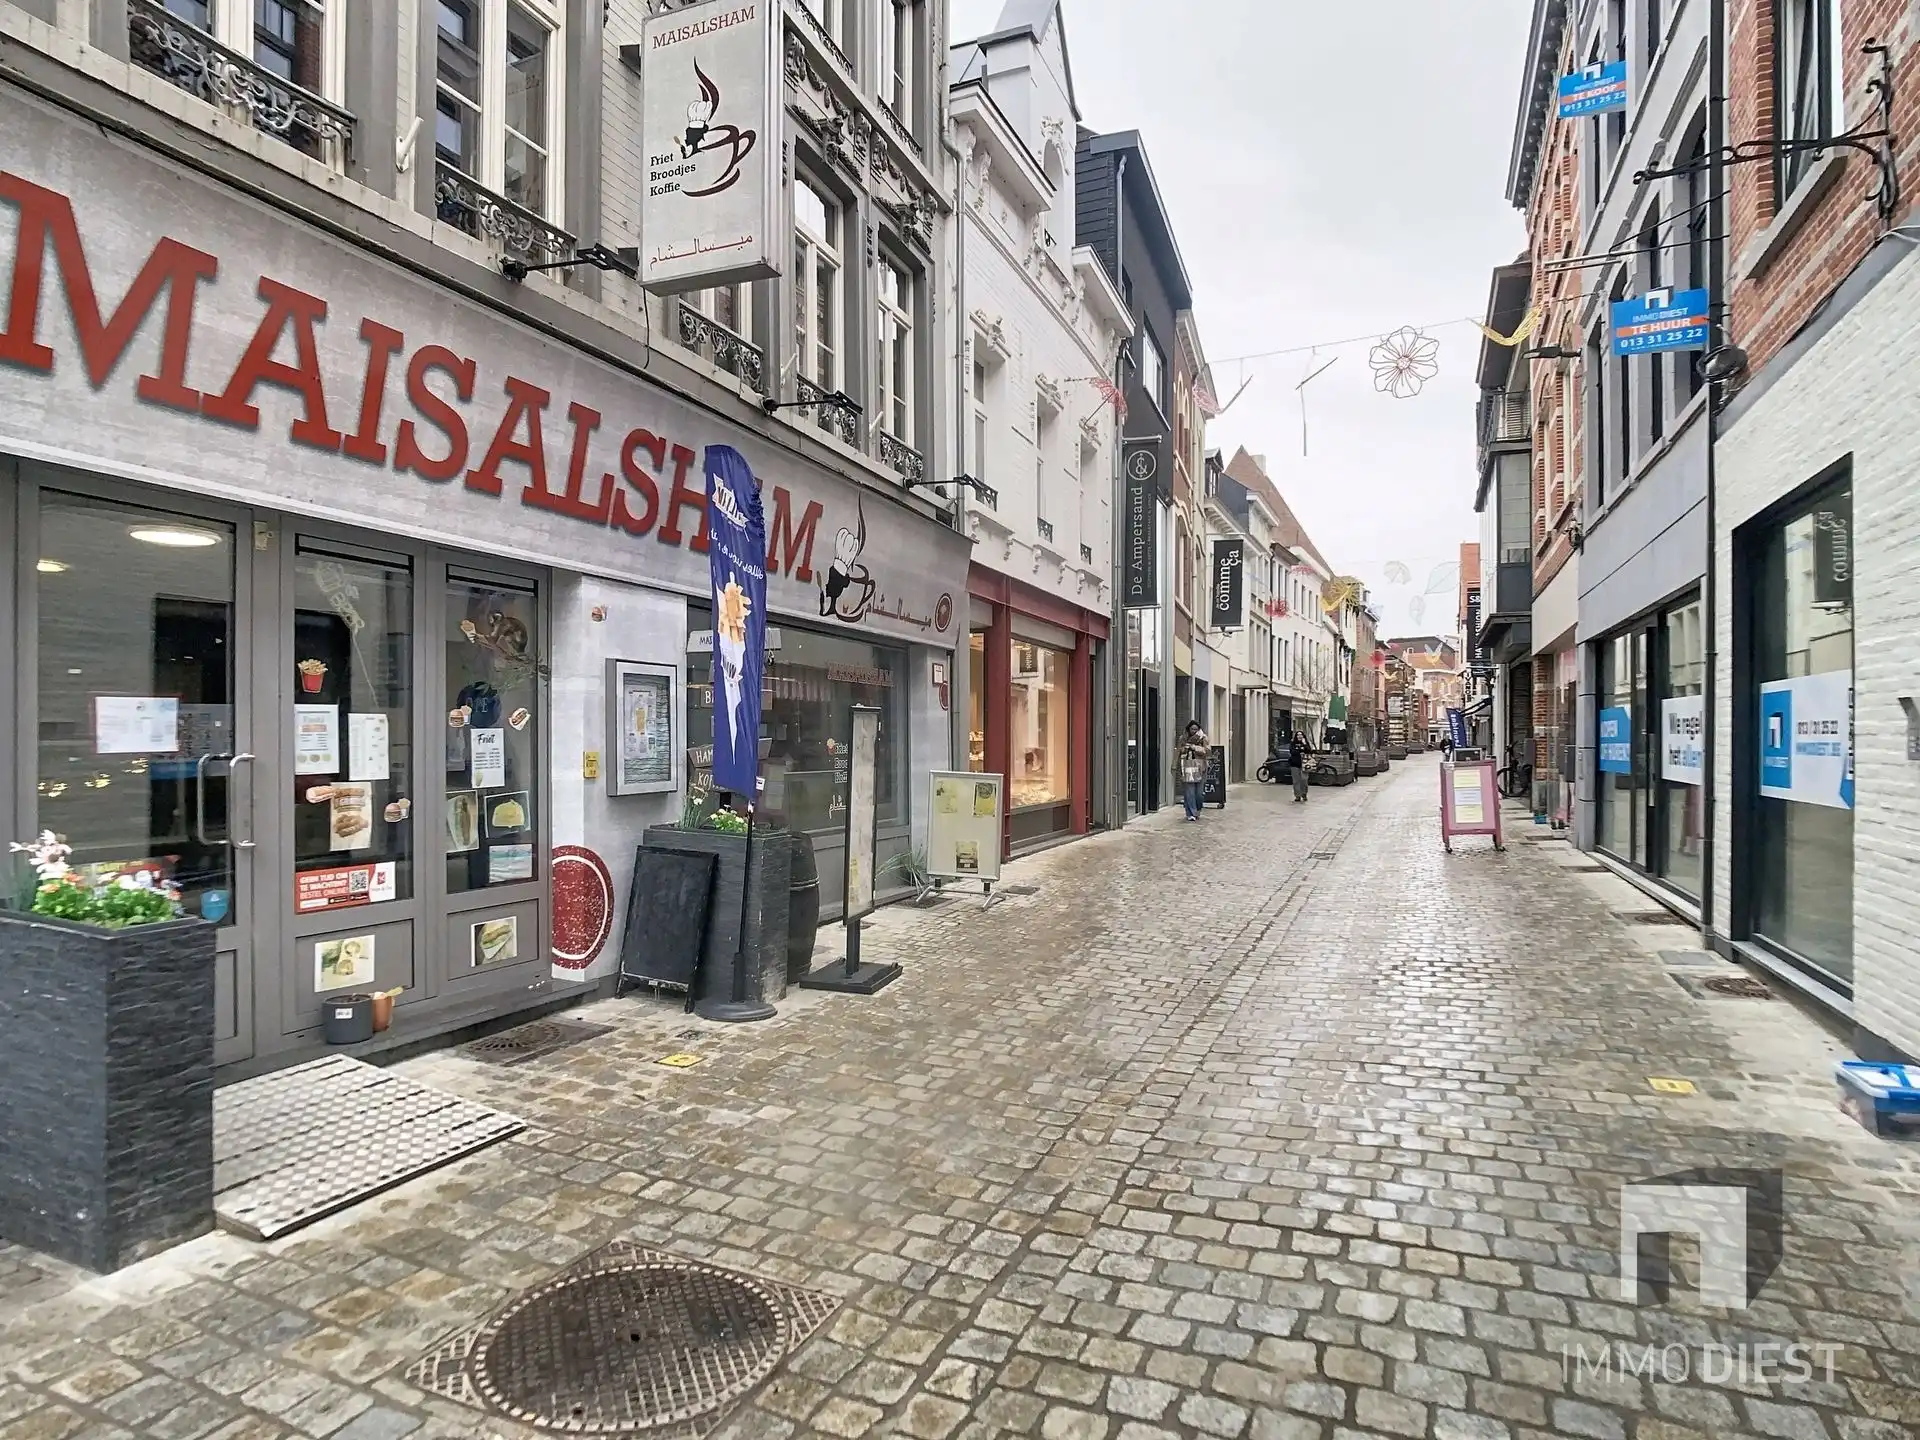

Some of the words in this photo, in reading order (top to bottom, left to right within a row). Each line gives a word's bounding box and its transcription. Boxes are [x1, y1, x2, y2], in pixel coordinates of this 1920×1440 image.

[653, 6, 755, 49] MAISALSHAM
[1572, 92, 1585, 101] TE
[1587, 84, 1617, 98] KOOP
[1585, 98, 1596, 107] 31
[1614, 91, 1625, 100] 22
[650, 153, 674, 167] Friet
[650, 163, 696, 181] Broodjes
[650, 182, 681, 197] Koffie
[1631, 324, 1649, 335] TE
[1650, 318, 1691, 332] HUUR
[1620, 337, 1643, 348] 013
[1647, 335, 1662, 345] 31
[1666, 331, 1683, 341] 25
[1687, 328, 1703, 337] 22
[0, 171, 823, 583] MAISALSHM
[1131, 485, 1145, 570] Ampersand
[1131, 575, 1143, 596] De
